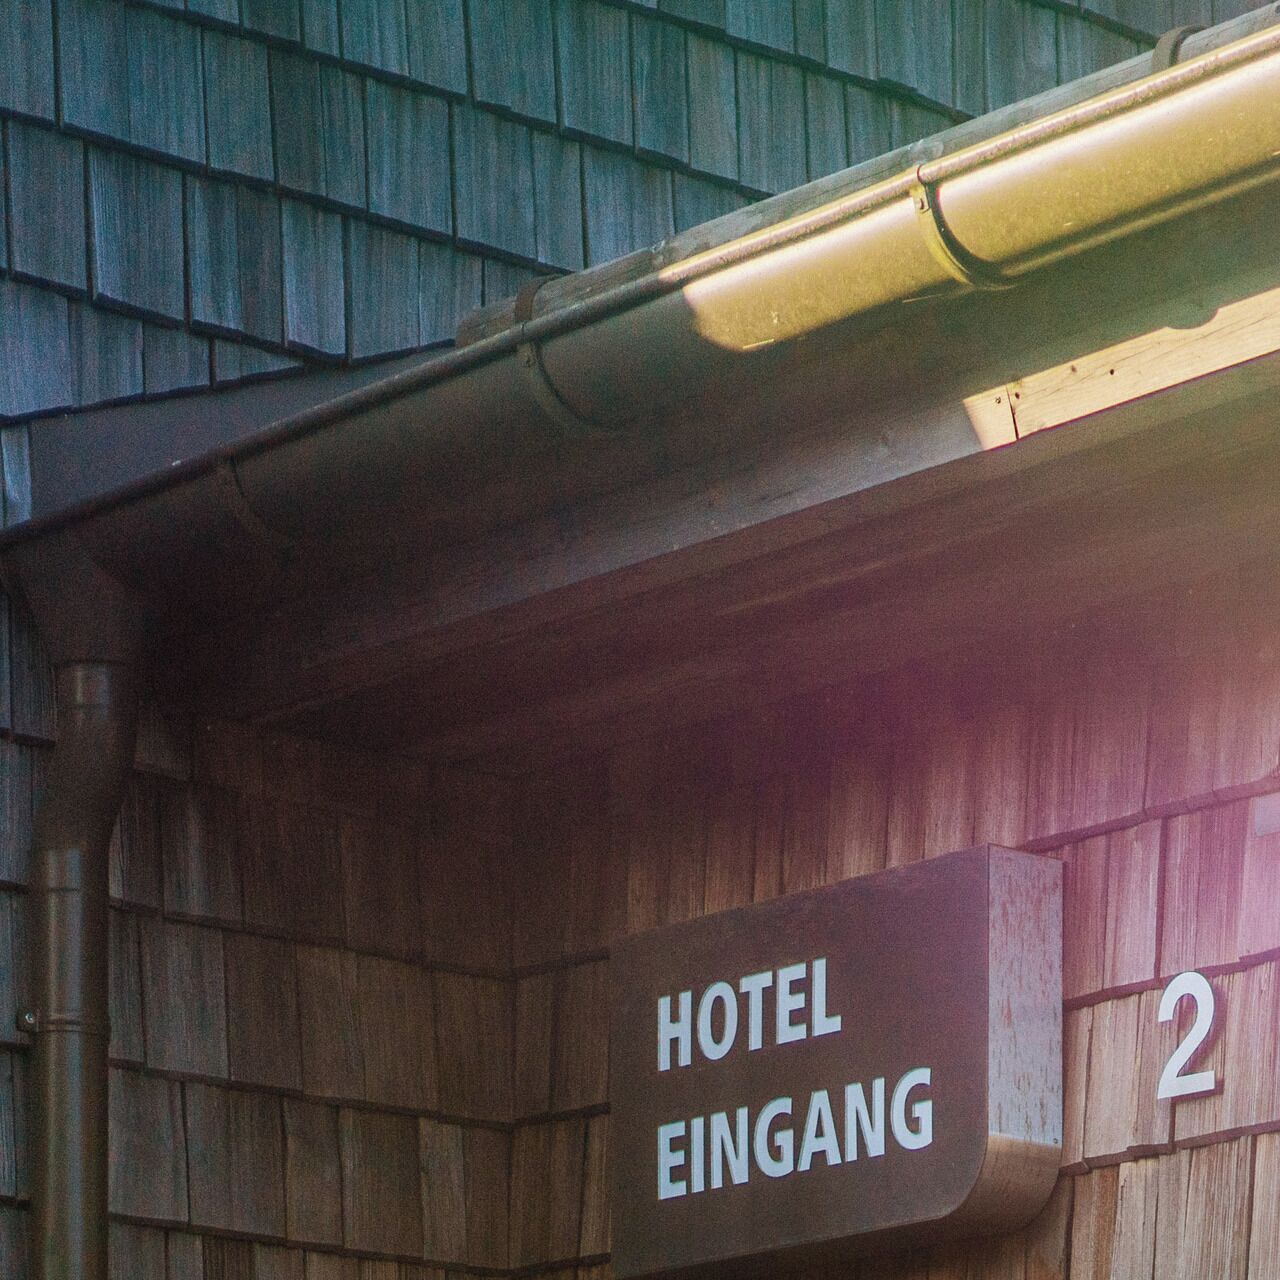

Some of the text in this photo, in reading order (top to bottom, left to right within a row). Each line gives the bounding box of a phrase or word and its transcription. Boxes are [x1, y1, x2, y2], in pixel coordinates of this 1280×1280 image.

[657, 957, 842, 1072] HOTEL
[1157, 970, 1216, 1099] 2
[657, 1066, 933, 1201] EINGANG
